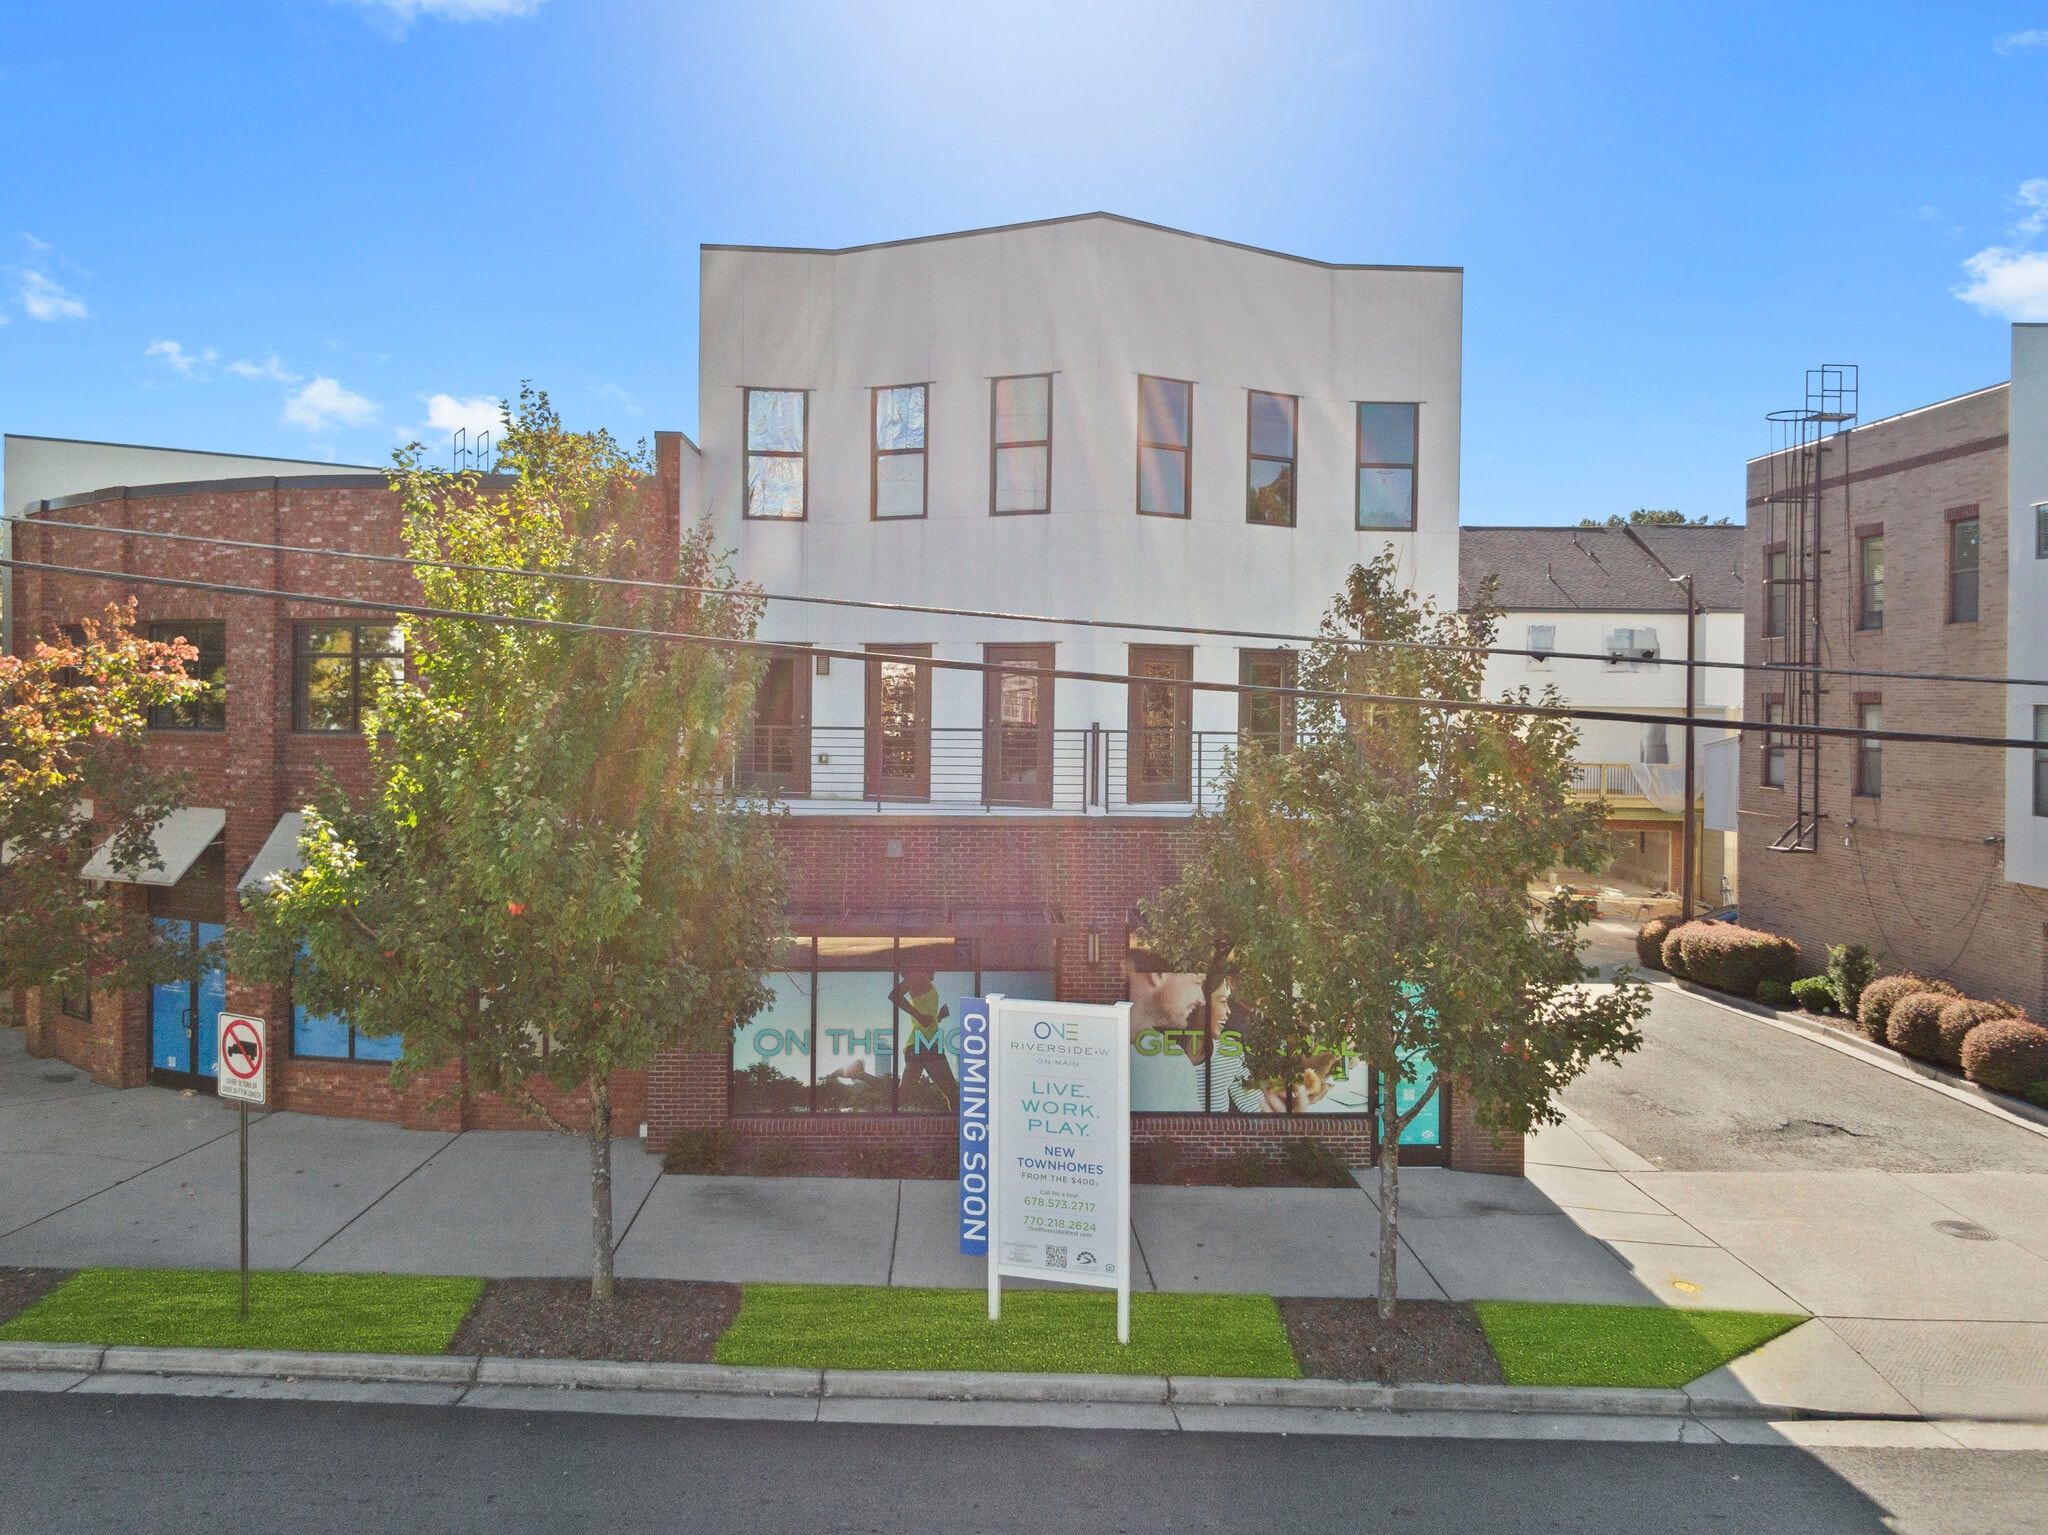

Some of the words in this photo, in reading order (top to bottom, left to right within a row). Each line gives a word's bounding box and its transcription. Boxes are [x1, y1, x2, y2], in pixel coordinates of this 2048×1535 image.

[1034, 1021, 1079, 1041] ONE
[753, 1028, 810, 1057] ON
[824, 1028, 894, 1056] THE
[1135, 1028, 1205, 1057] GET
[1055, 1059, 1079, 1067] MAIN
[963, 1013, 987, 1142] COMING
[1032, 1081, 1090, 1098] LIVE.
[1021, 1099, 1100, 1118] WORK.
[1028, 1119, 1090, 1136] PLAY.
[1044, 1146, 1076, 1158] NEW
[1017, 1157, 1104, 1175] TOWNHOMES
[1021, 1172, 1047, 1181] FROM
[1051, 1175, 1068, 1183] THE
[963, 1151, 986, 1241] SOON
[1024, 1196, 1096, 1212] 678.573.2717
[1023, 1215, 1097, 1232] 770.218.2624
